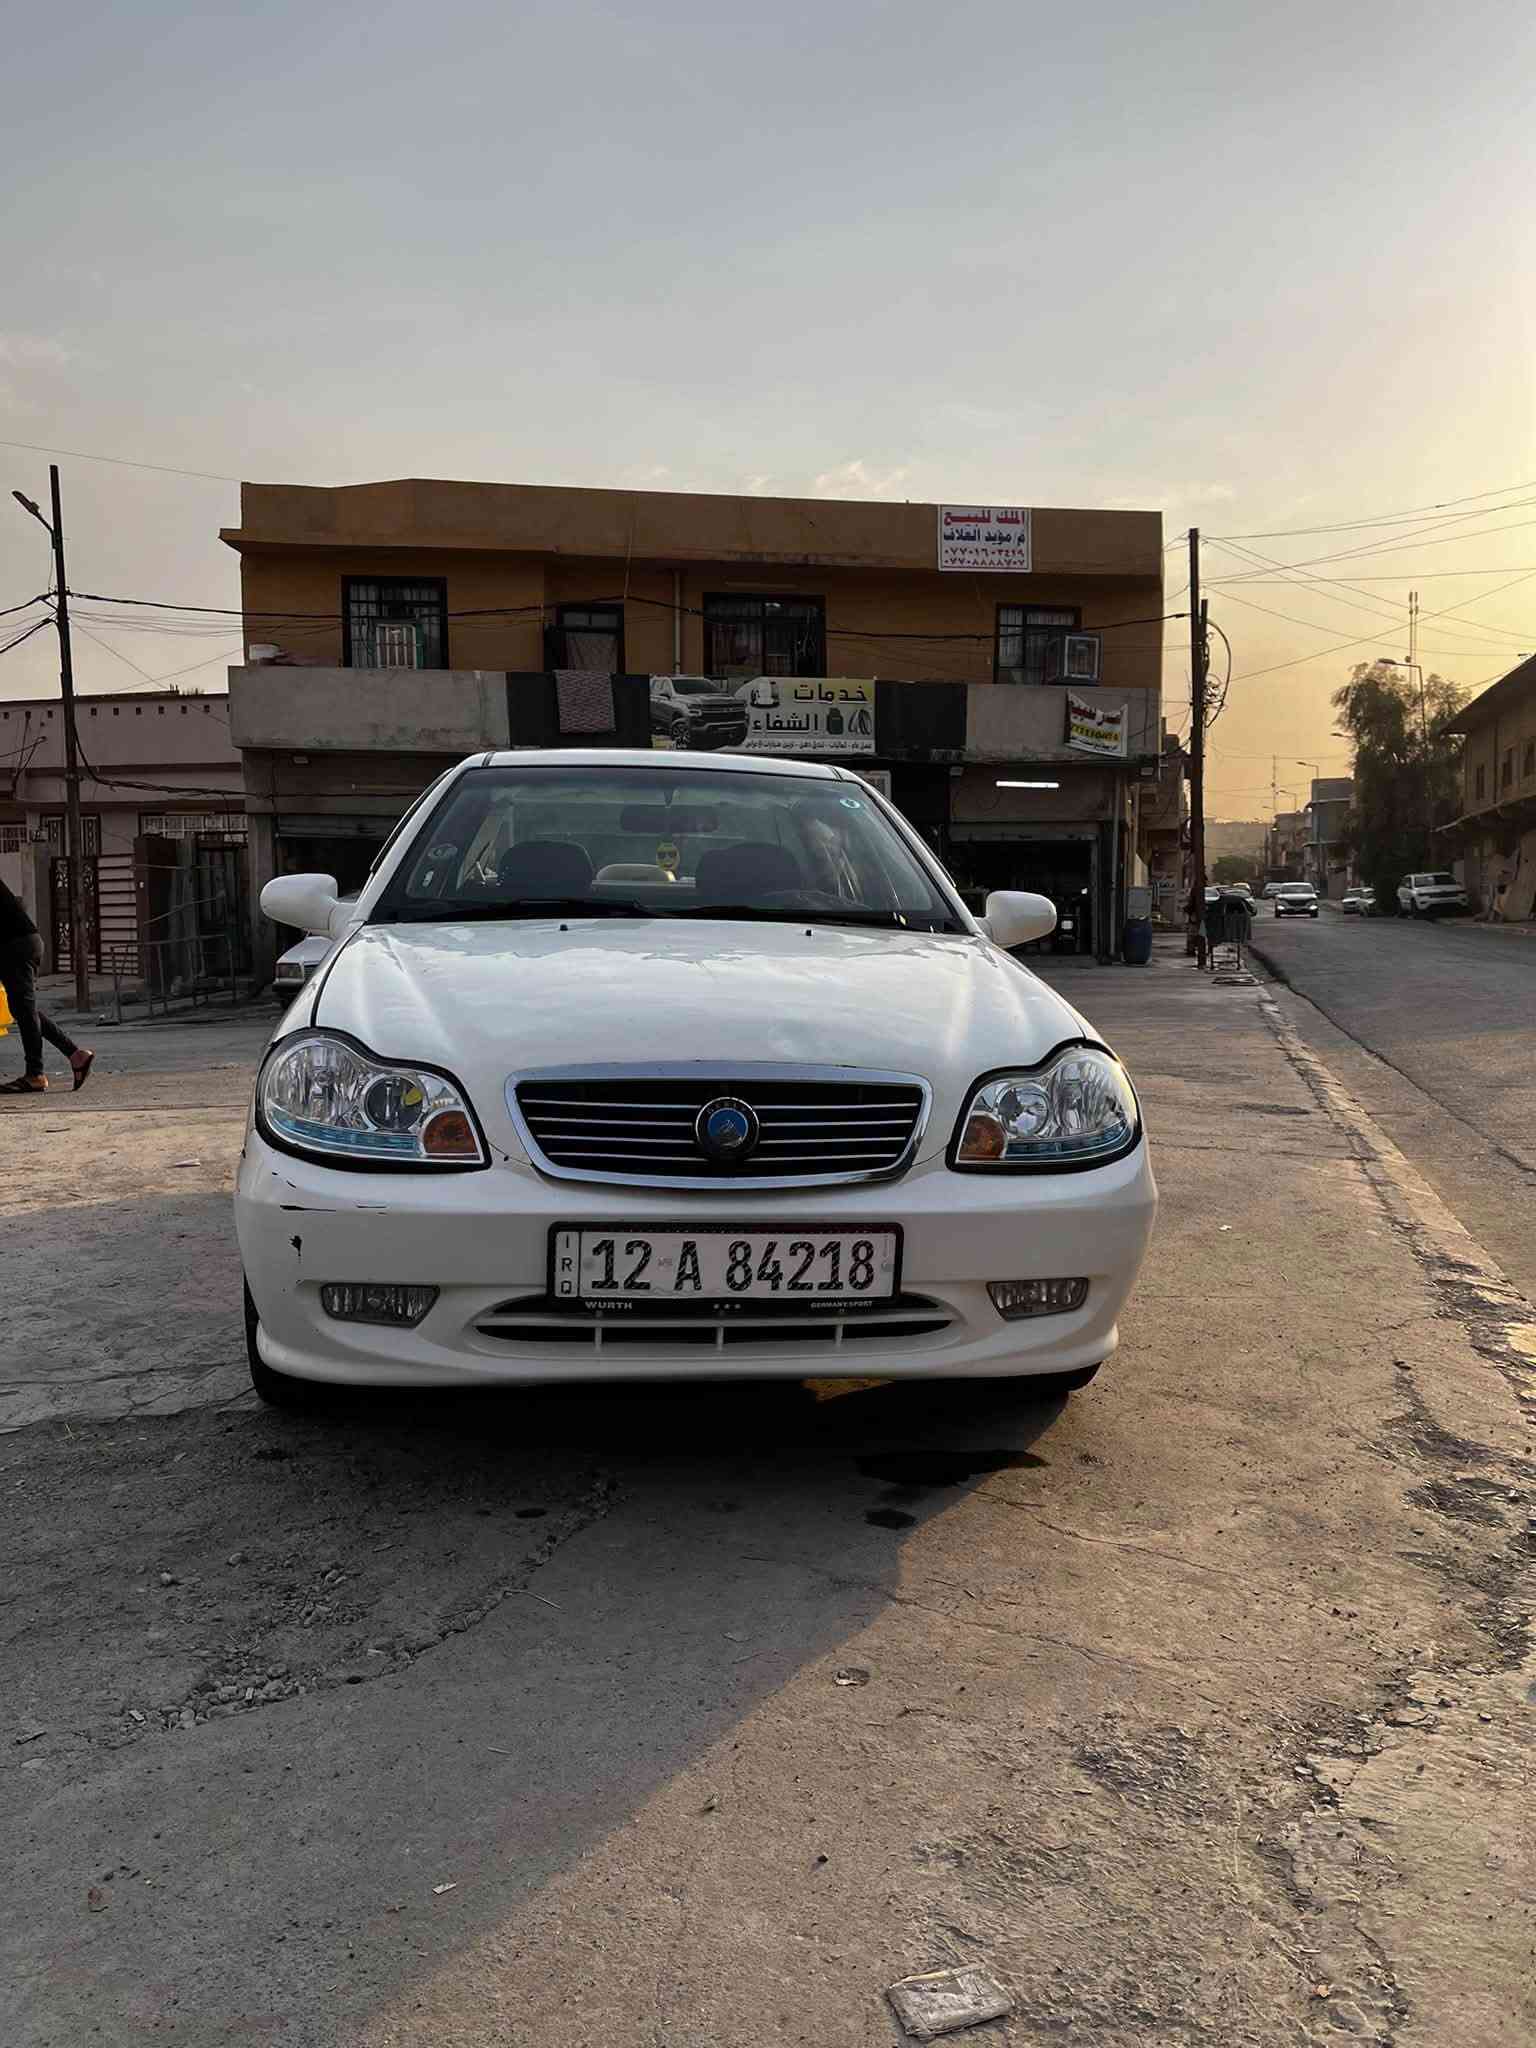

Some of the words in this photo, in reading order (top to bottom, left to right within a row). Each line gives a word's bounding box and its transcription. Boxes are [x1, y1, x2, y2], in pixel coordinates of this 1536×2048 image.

[943, 509, 991, 527] للبيع
[794, 683, 868, 703] خدمات
[752, 712, 819, 731] الشفاء
[592, 1239, 653, 1290] 12
[674, 1240, 702, 1291] A
[725, 1239, 875, 1291] 84218
